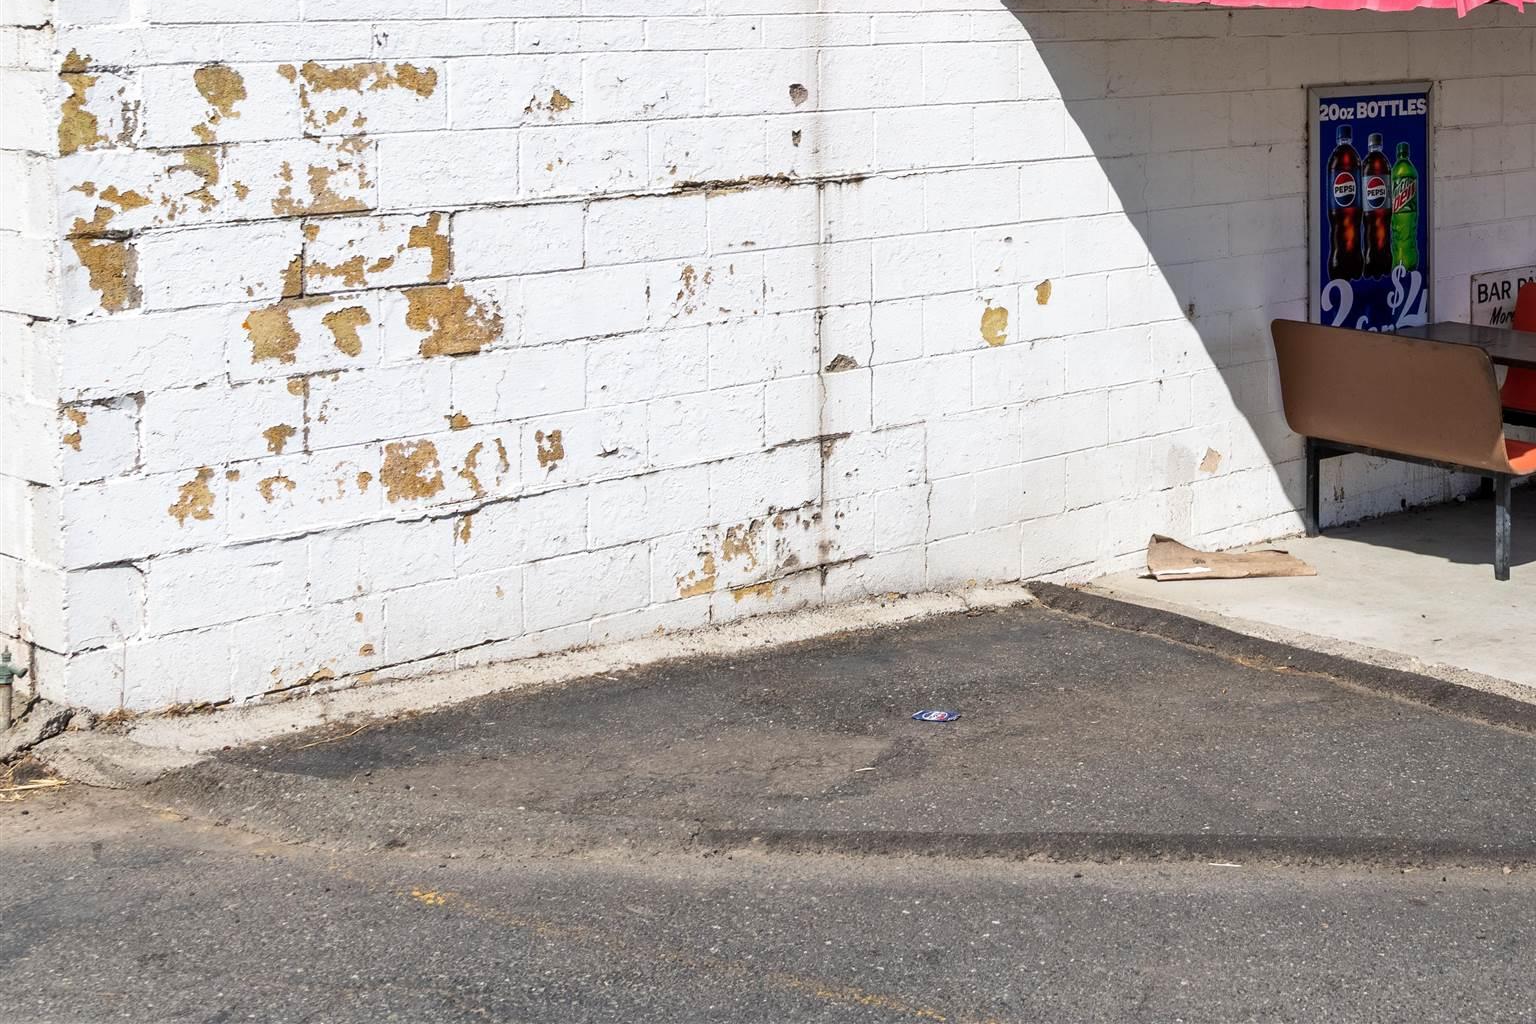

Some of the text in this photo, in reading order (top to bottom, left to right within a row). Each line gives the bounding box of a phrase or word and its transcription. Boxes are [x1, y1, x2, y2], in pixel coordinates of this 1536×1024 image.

[1320, 98, 1427, 122] 20oz BOTTLES
[1335, 184, 1355, 194] PEPSI
[1367, 187, 1386, 197] PEPSI
[1477, 280, 1512, 304] BAR
